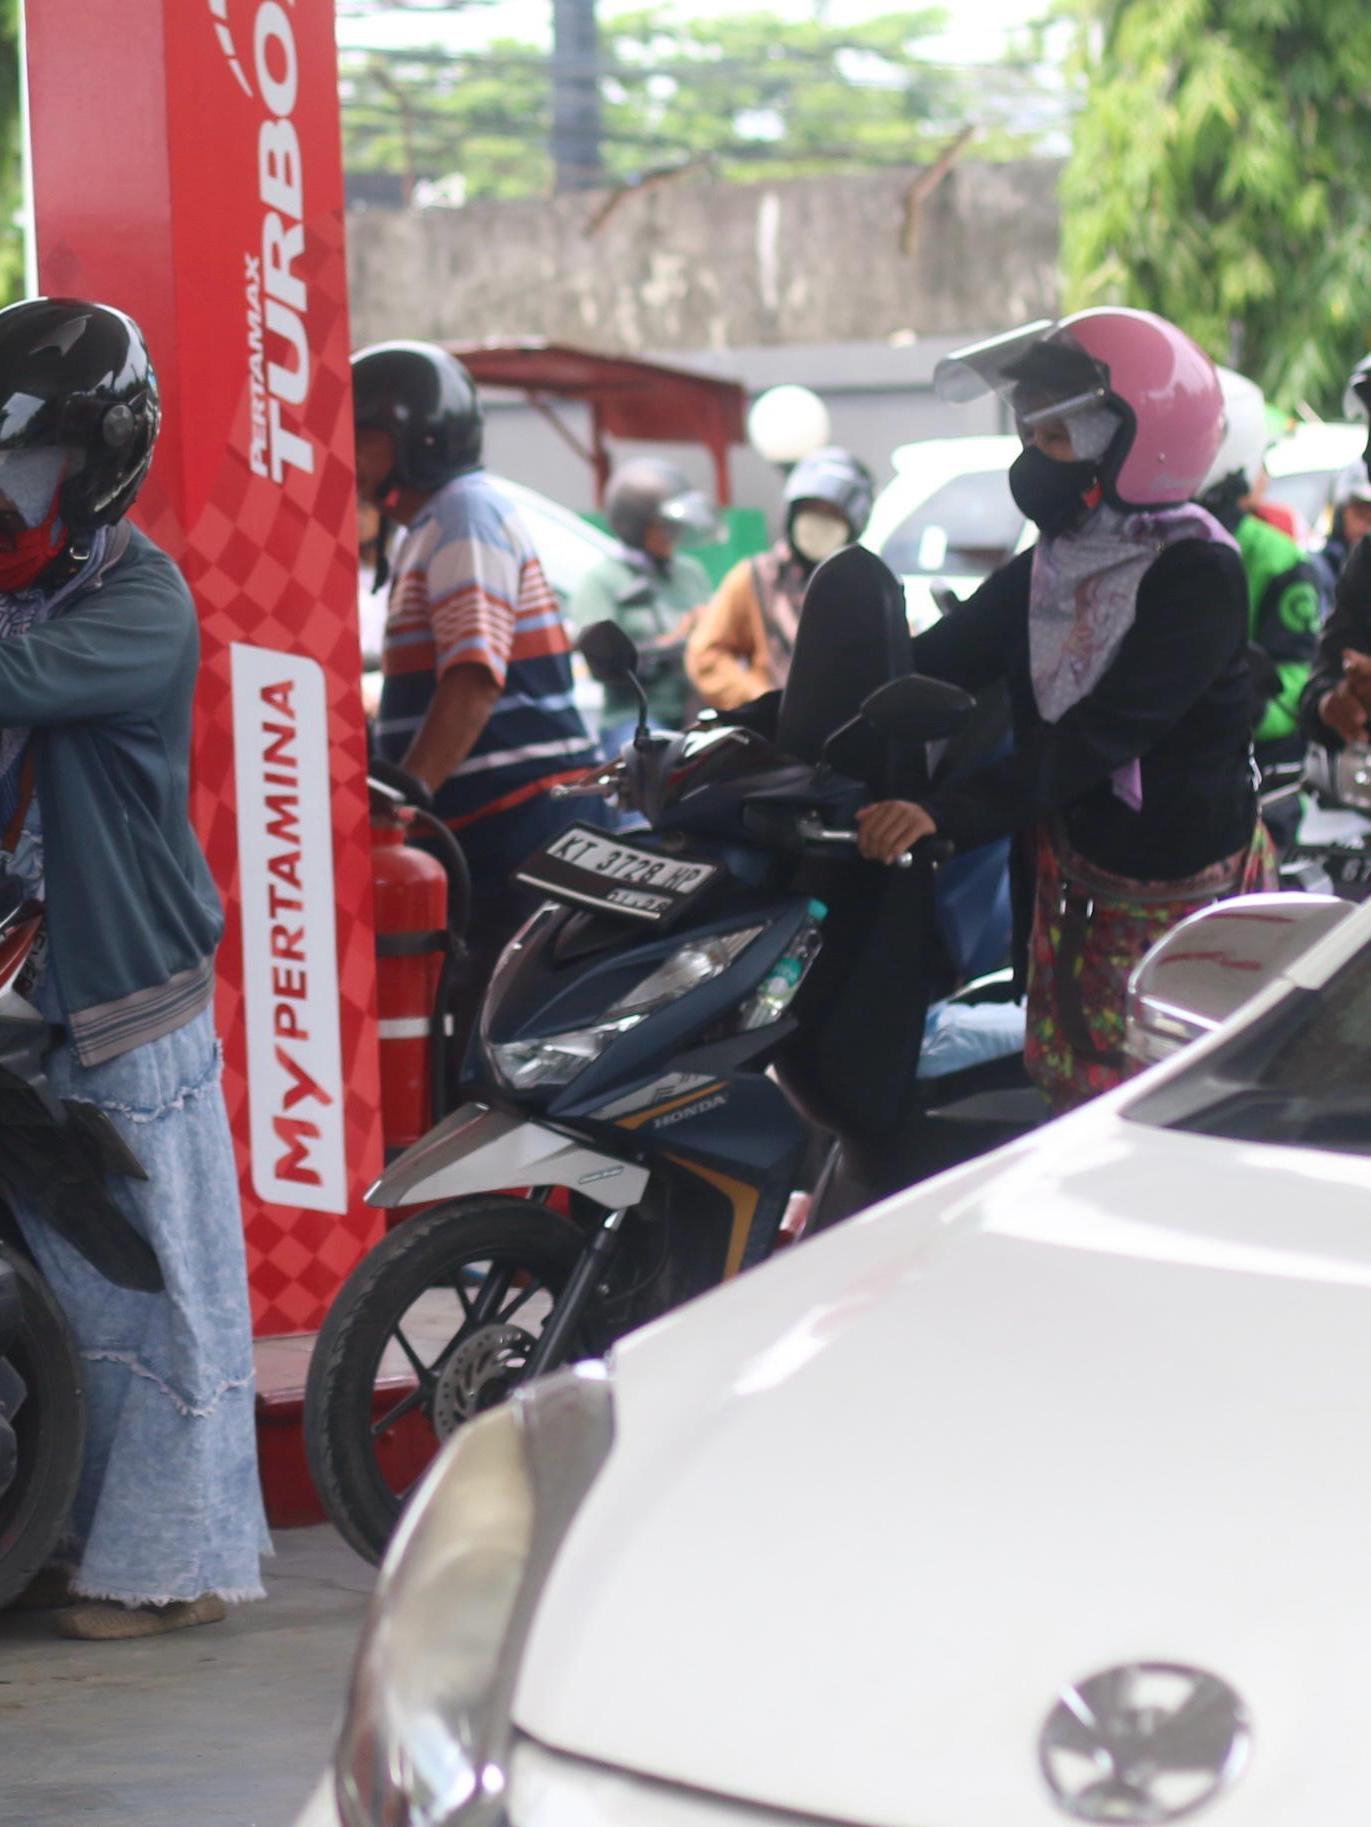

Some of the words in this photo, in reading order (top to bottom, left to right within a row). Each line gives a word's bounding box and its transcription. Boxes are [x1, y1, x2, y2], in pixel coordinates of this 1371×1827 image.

[253, 1, 315, 484] TURBO
[244, 252, 269, 478] PERTAMAX
[556, 835, 599, 866] KT
[596, 850, 666, 884] 3728
[654, 1095, 727, 1129] HONDA
